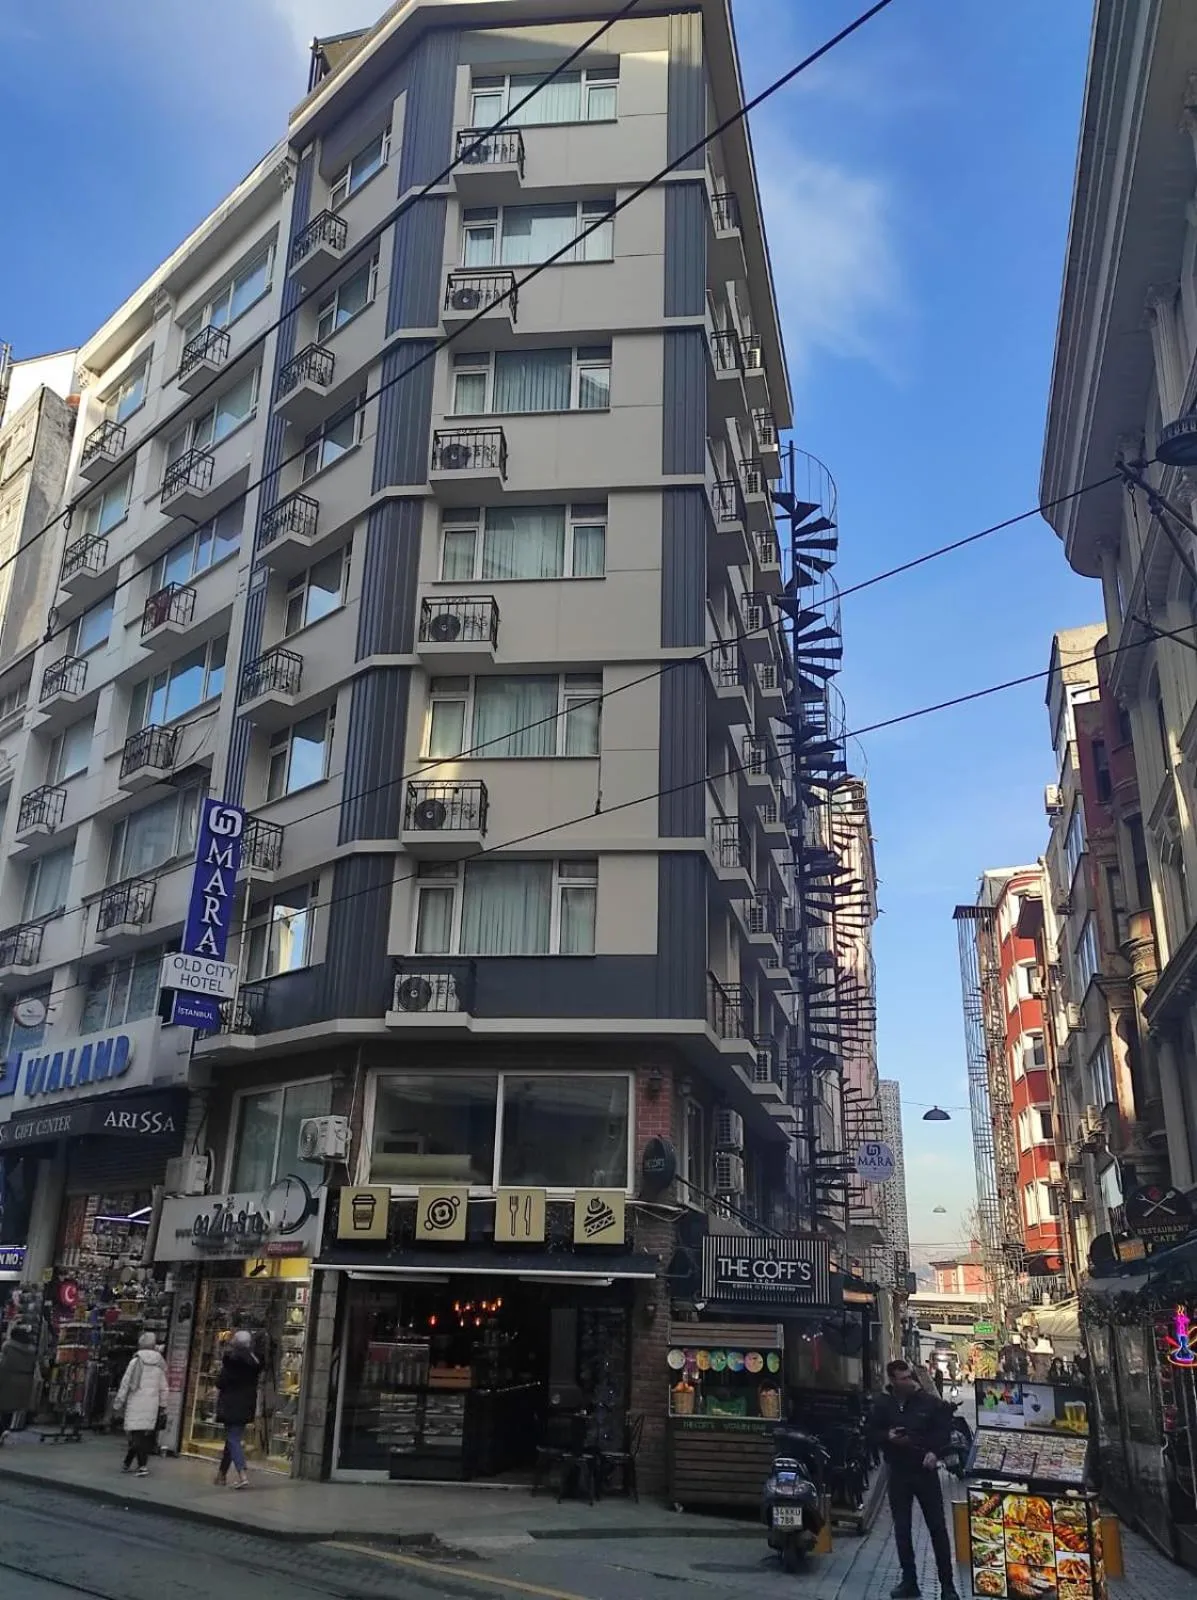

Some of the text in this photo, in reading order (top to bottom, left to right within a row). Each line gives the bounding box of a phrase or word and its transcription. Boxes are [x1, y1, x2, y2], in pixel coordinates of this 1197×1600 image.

[194, 837, 234, 955] MARA
[173, 957, 237, 979] OLD CITY
[180, 973, 225, 993] HOTEL
[36, 1115, 72, 1136] CENTER
[858, 1156, 893, 1166] MARA
[718, 1258, 811, 1281] THE COFF'S
